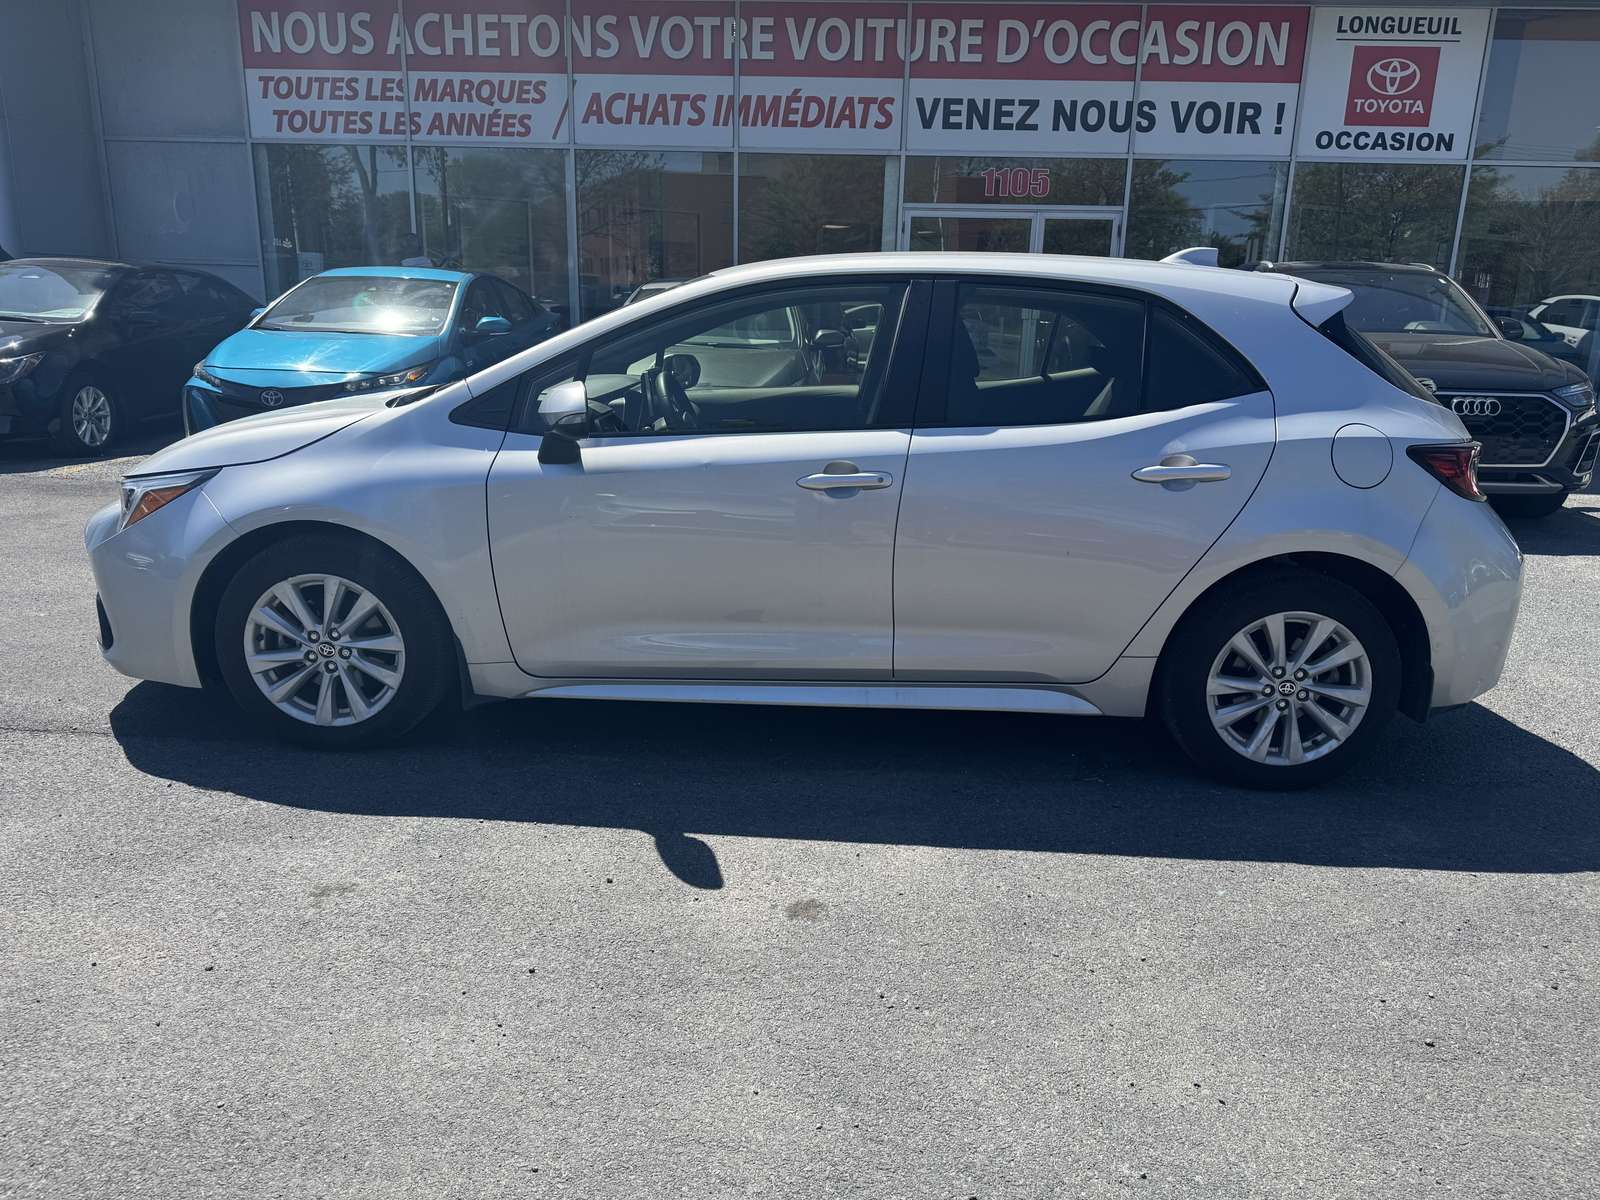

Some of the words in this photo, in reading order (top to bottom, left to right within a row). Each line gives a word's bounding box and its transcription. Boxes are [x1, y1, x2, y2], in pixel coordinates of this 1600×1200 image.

[250, 10, 374, 55] NOUS
[386, 13, 620, 58] ACHETONS
[629, 15, 775, 60] VOTRE
[785, 17, 984, 63] VOITURE
[1337, 15, 1462, 35] LONGUEUIL
[258, 76, 359, 102] TOUTES
[365, 78, 407, 102] LES
[414, 79, 547, 107] MARQUES
[582, 92, 706, 127] ACHATS
[712, 88, 895, 130] IMMÉDIATS
[916, 97, 1039, 131] VENEZ
[1052, 99, 1157, 133] NOUS
[1171, 101, 1262, 135] VOIR
[1274, 102, 1286, 135] !
[1354, 99, 1425, 114] TOYOTA
[272, 110, 373, 135] TOUTES
[379, 112, 422, 135] LES
[426, 109, 532, 137] ANNÉES
[1315, 131, 1455, 152] OCCASION
[981, 168, 1050, 197] 1105
